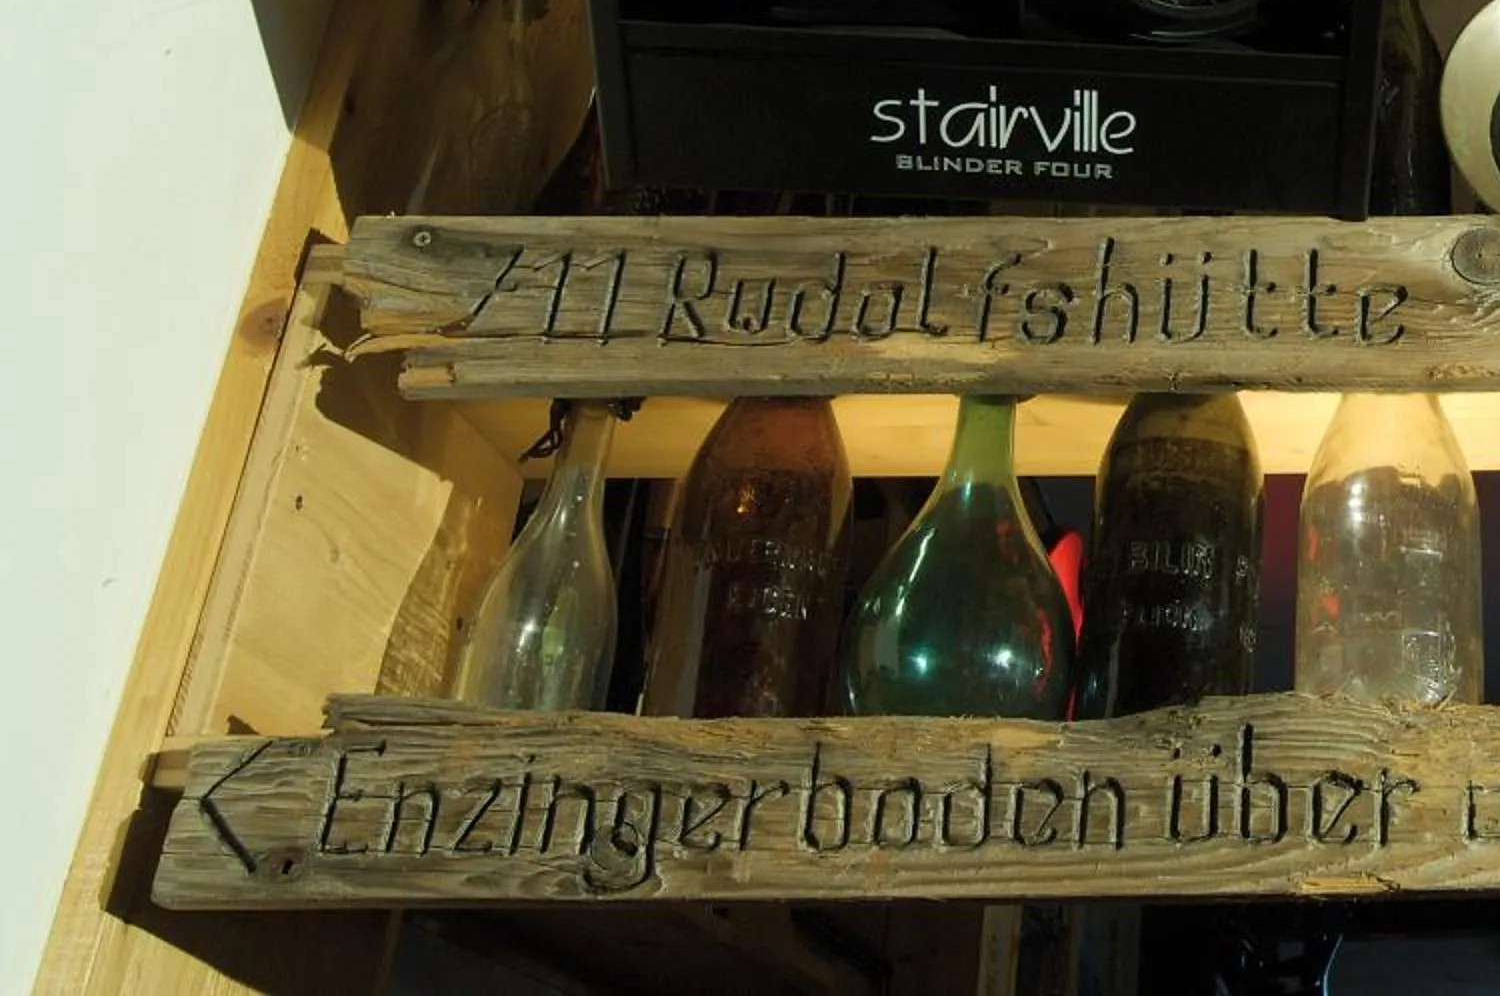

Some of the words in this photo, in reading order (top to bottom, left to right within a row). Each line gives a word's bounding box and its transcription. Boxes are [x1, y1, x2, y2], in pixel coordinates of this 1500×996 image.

[870, 85, 1137, 155] stairville
[896, 155, 1024, 176] BLINDER
[1034, 160, 1114, 180] FOUR
[657, 236, 1407, 346] Rudolfshütte
[317, 738, 1126, 894] Enzingerboden
[1165, 724, 1422, 849] über
